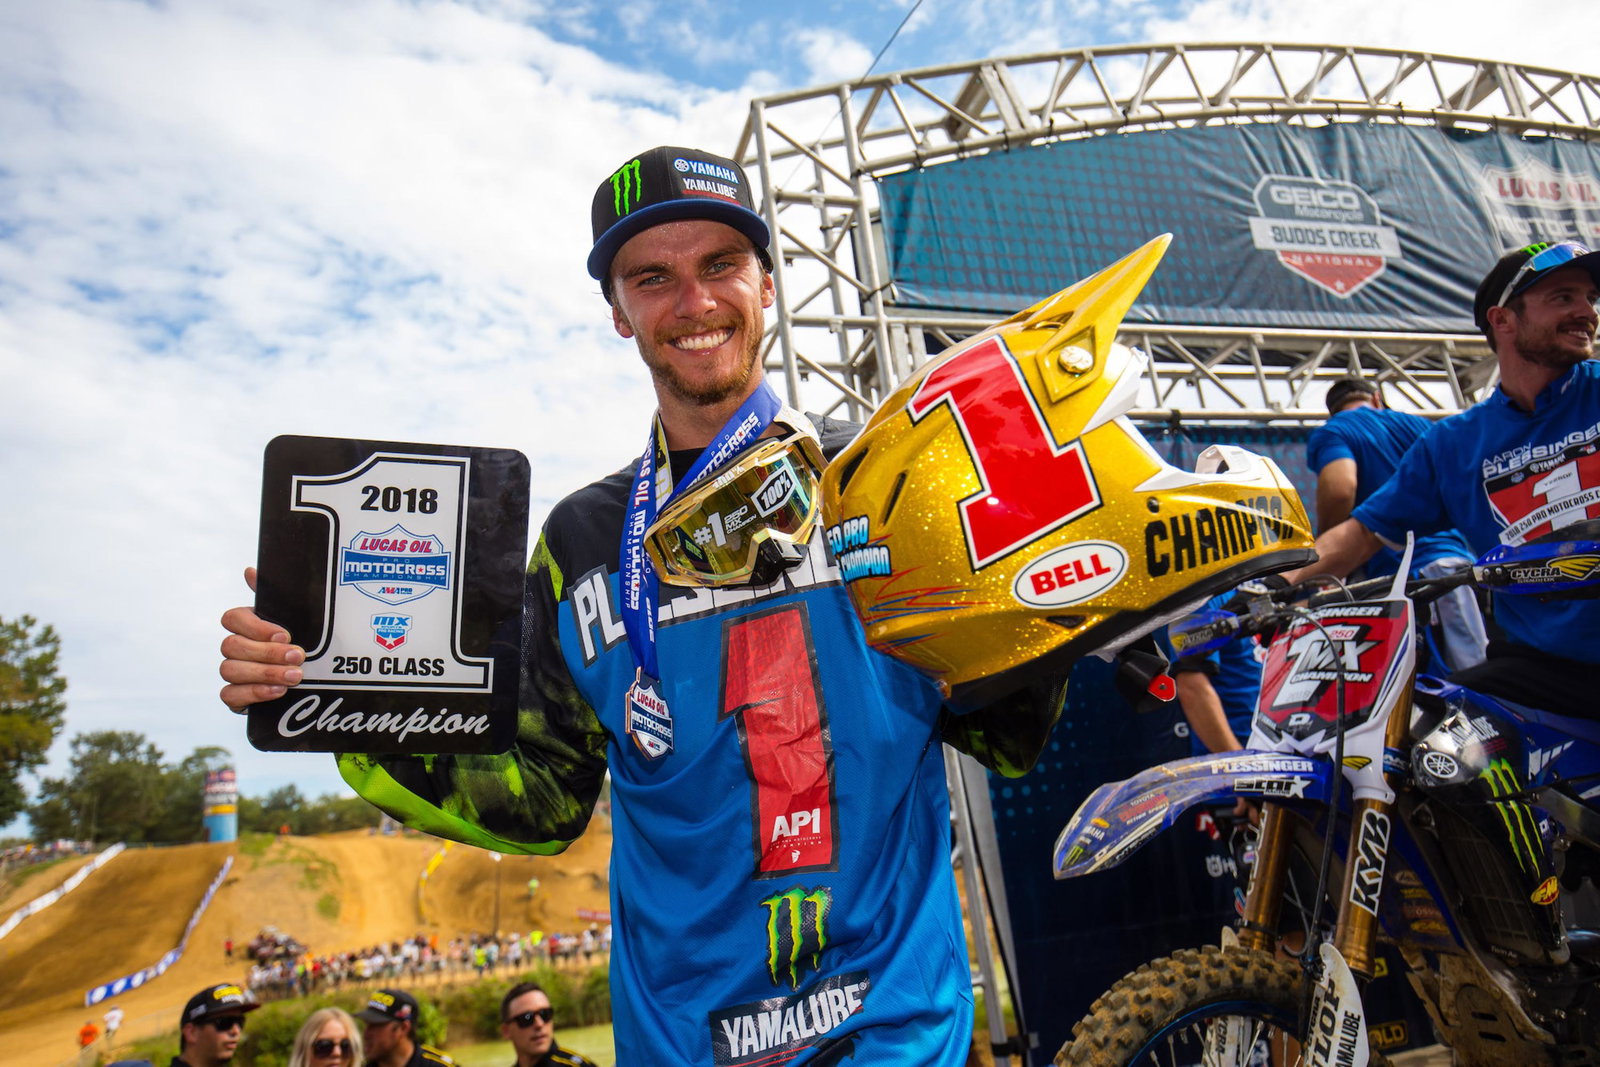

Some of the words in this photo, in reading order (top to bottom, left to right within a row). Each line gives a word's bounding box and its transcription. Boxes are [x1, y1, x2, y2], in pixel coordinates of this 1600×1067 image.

[689, 161, 739, 184] YAMAHA
[682, 177, 738, 199] YAMALUBE
[1269, 185, 1361, 210] GEICO
[1497, 177, 1562, 201] LUCAS
[1567, 182, 1597, 202] OIL
[1271, 225, 1327, 245] BUDDS
[1328, 230, 1381, 249] CREEK
[686, 411, 759, 489] OTOCROSS
[906, 334, 1103, 572] 1
[1482, 441, 1532, 468] AARON
[360, 485, 439, 514] 2018
[761, 471, 791, 510] 100%
[724, 504, 748, 524] 250
[1532, 510, 1547, 524] PRO
[1546, 493, 1595, 515] MOTOCROSS
[693, 511, 727, 547] #1
[726, 518, 742, 530] MX
[843, 515, 869, 548] PRO
[360, 538, 408, 552] LUCAS
[409, 540, 432, 553] OIL
[345, 561, 446, 576] MOTOCROSS
[345, 572, 446, 580] CHAMPIONSHIP
[1030, 553, 1112, 596] BELL
[1510, 566, 1562, 579] CYCRA
[332, 655, 372, 675] 250
[378, 657, 445, 677] CLASS
[1297, 640, 1378, 674] MX
[636, 691, 656, 710] LUCAS
[656, 702, 666, 716] OIL
[277, 694, 490, 743] Champion
[1349, 808, 1391, 918] KYB
[720, 981, 868, 1058] YAMALUBE
